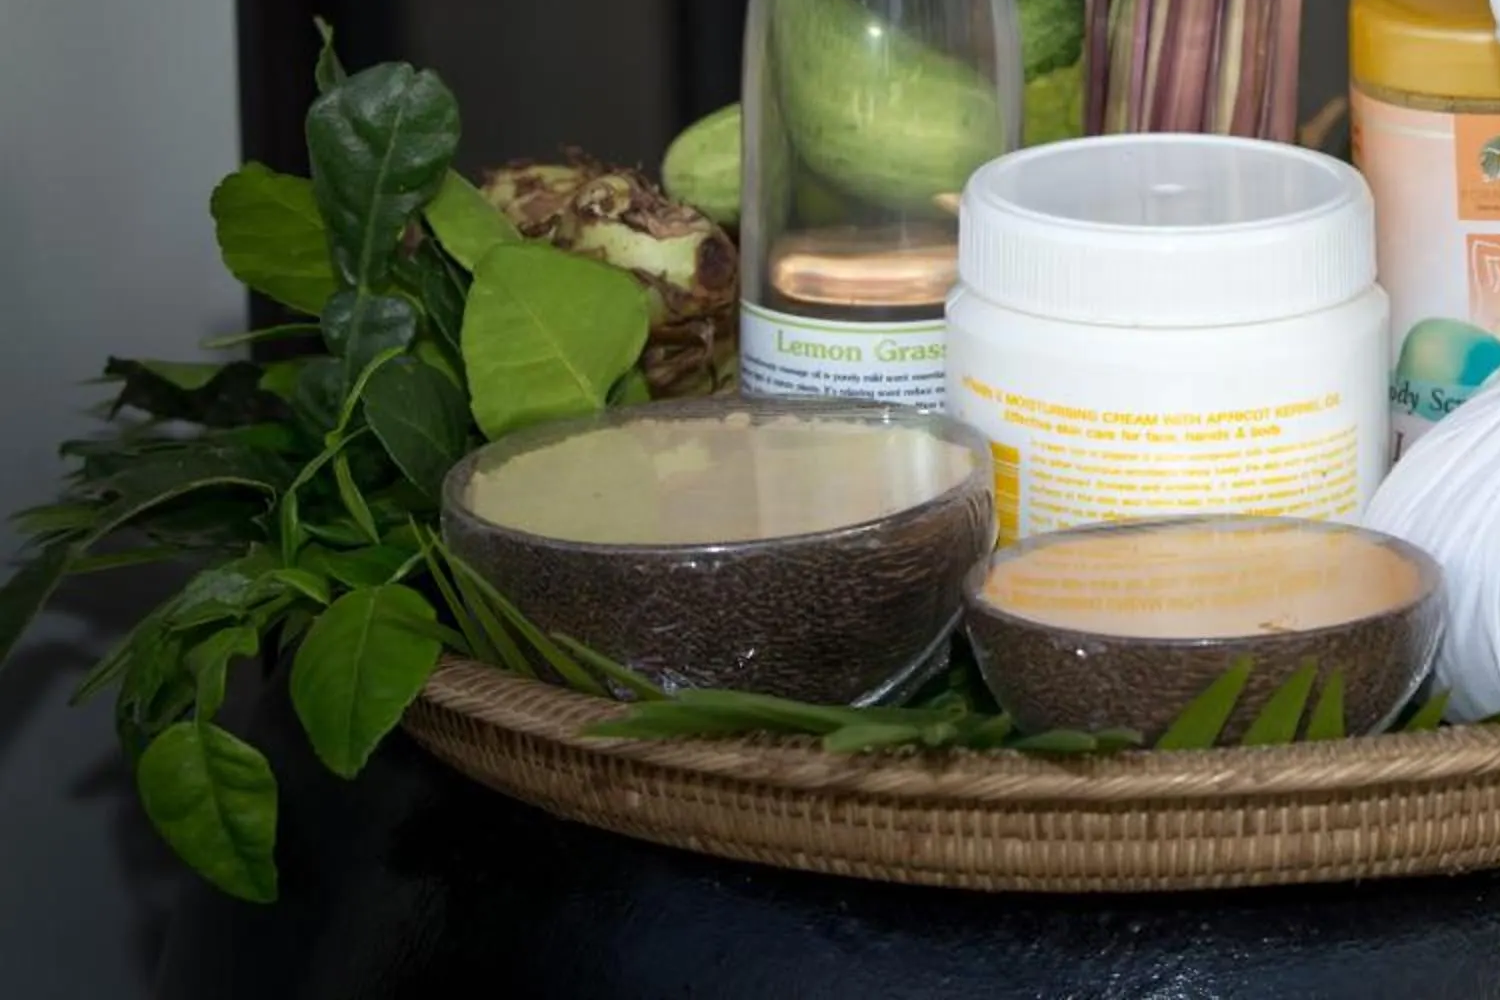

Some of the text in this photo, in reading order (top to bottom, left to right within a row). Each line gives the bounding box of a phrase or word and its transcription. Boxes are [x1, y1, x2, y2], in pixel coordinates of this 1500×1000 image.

[777, 329, 862, 362] Lemon
[1389, 381, 1419, 414] ody
[1102, 410, 1158, 426] CREAM
